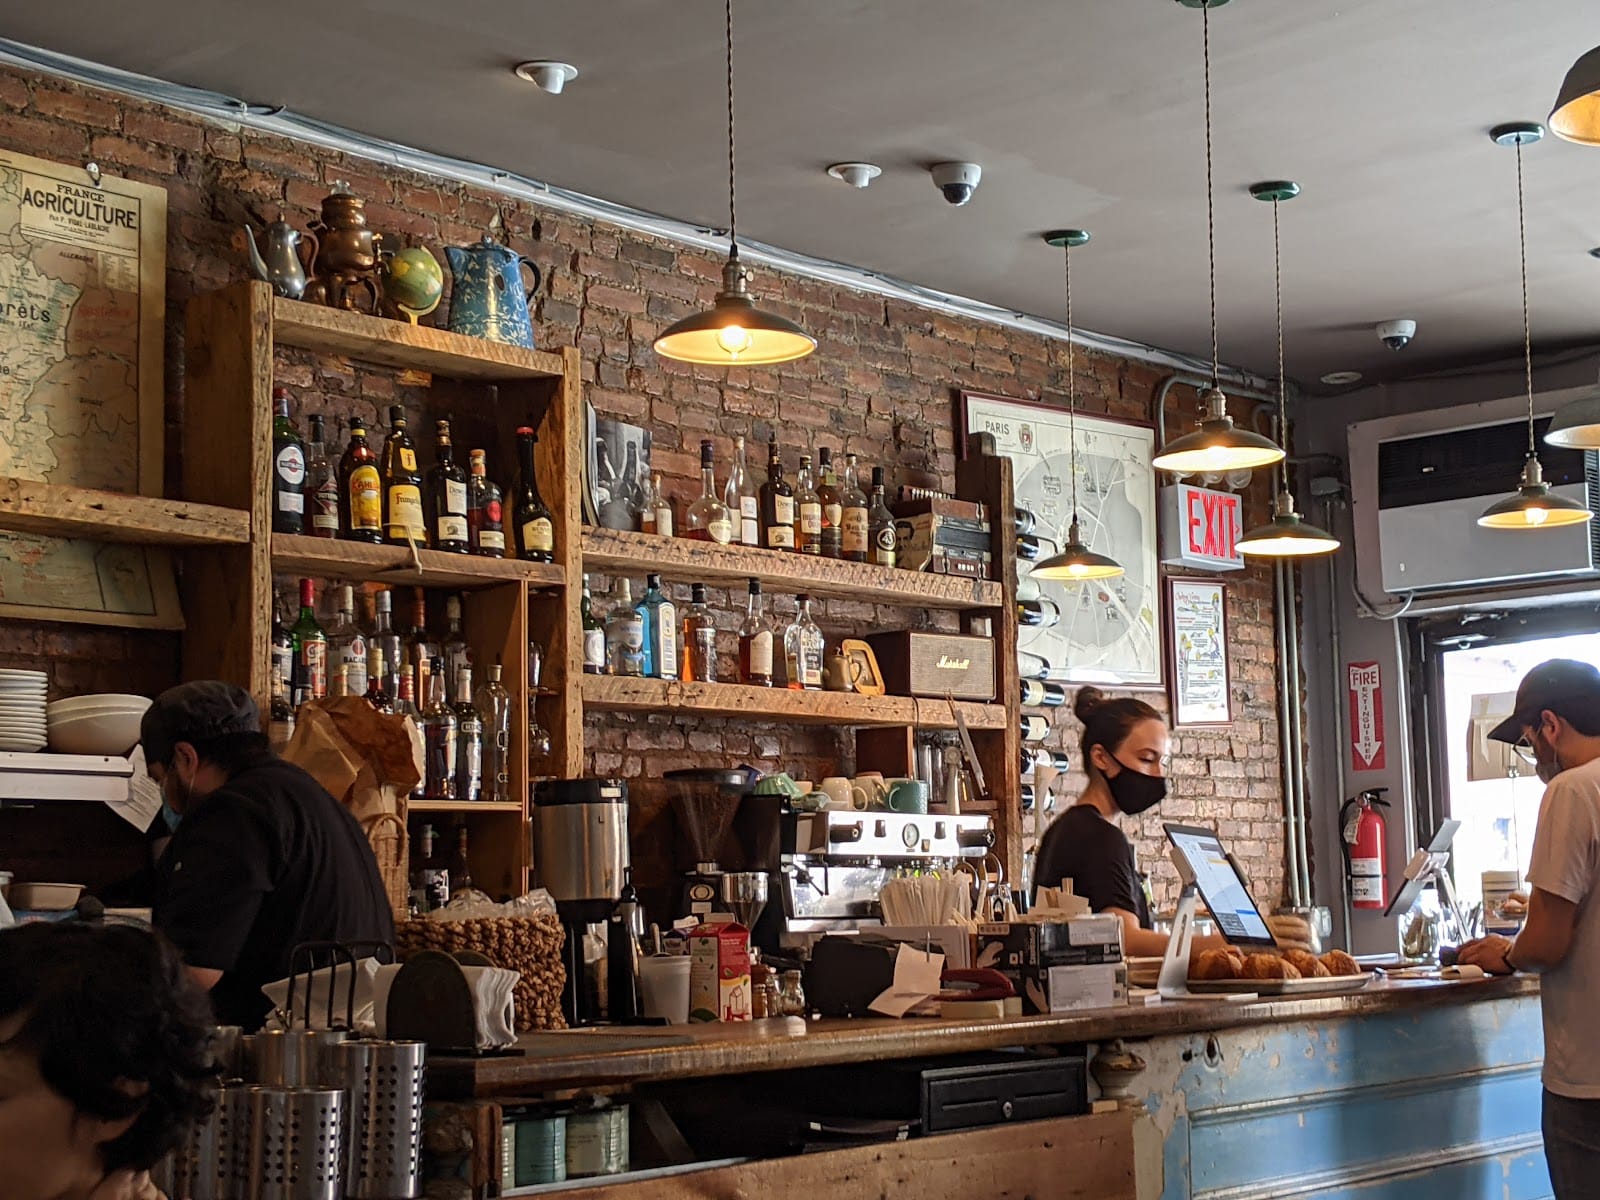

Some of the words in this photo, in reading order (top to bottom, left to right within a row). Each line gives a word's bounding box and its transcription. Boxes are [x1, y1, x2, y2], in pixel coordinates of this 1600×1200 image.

[56, 183, 105, 203] FRANCE
[22, 187, 137, 230] AGRICULTURE
[985, 420, 1010, 435] PARIS
[1186, 489, 1237, 561] EXIT
[935, 654, 970, 670] Marshall
[1352, 671, 1377, 687] FIRE
[1361, 686, 1372, 760] EXTINGUISHER
